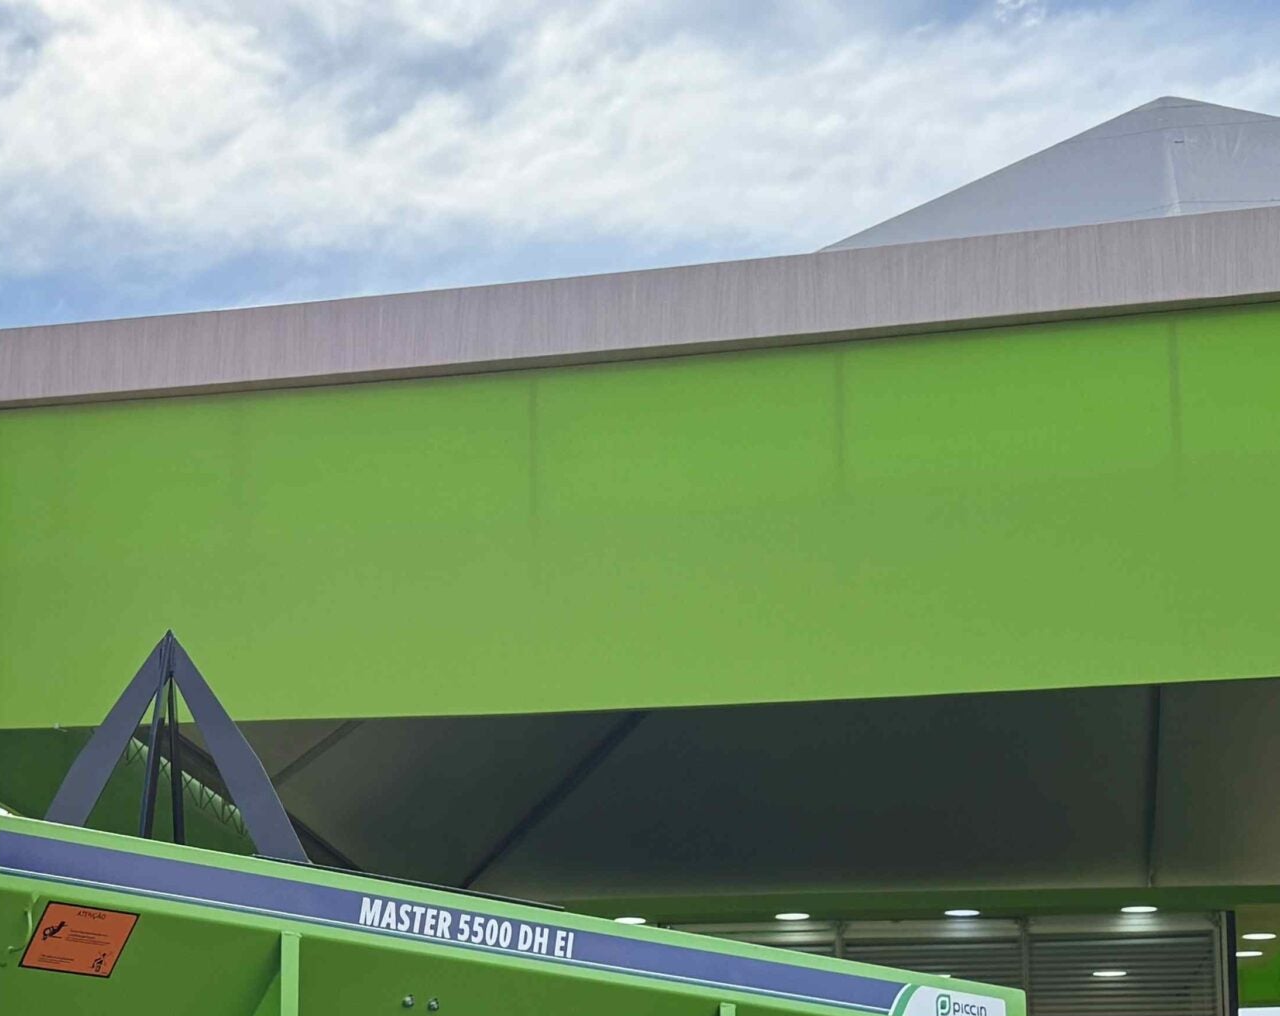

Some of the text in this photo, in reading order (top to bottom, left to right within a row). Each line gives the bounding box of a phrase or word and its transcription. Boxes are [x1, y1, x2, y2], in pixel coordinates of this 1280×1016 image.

[358, 897, 451, 939] MASTER
[456, 914, 513, 948] 5500
[517, 923, 549, 954] DH
